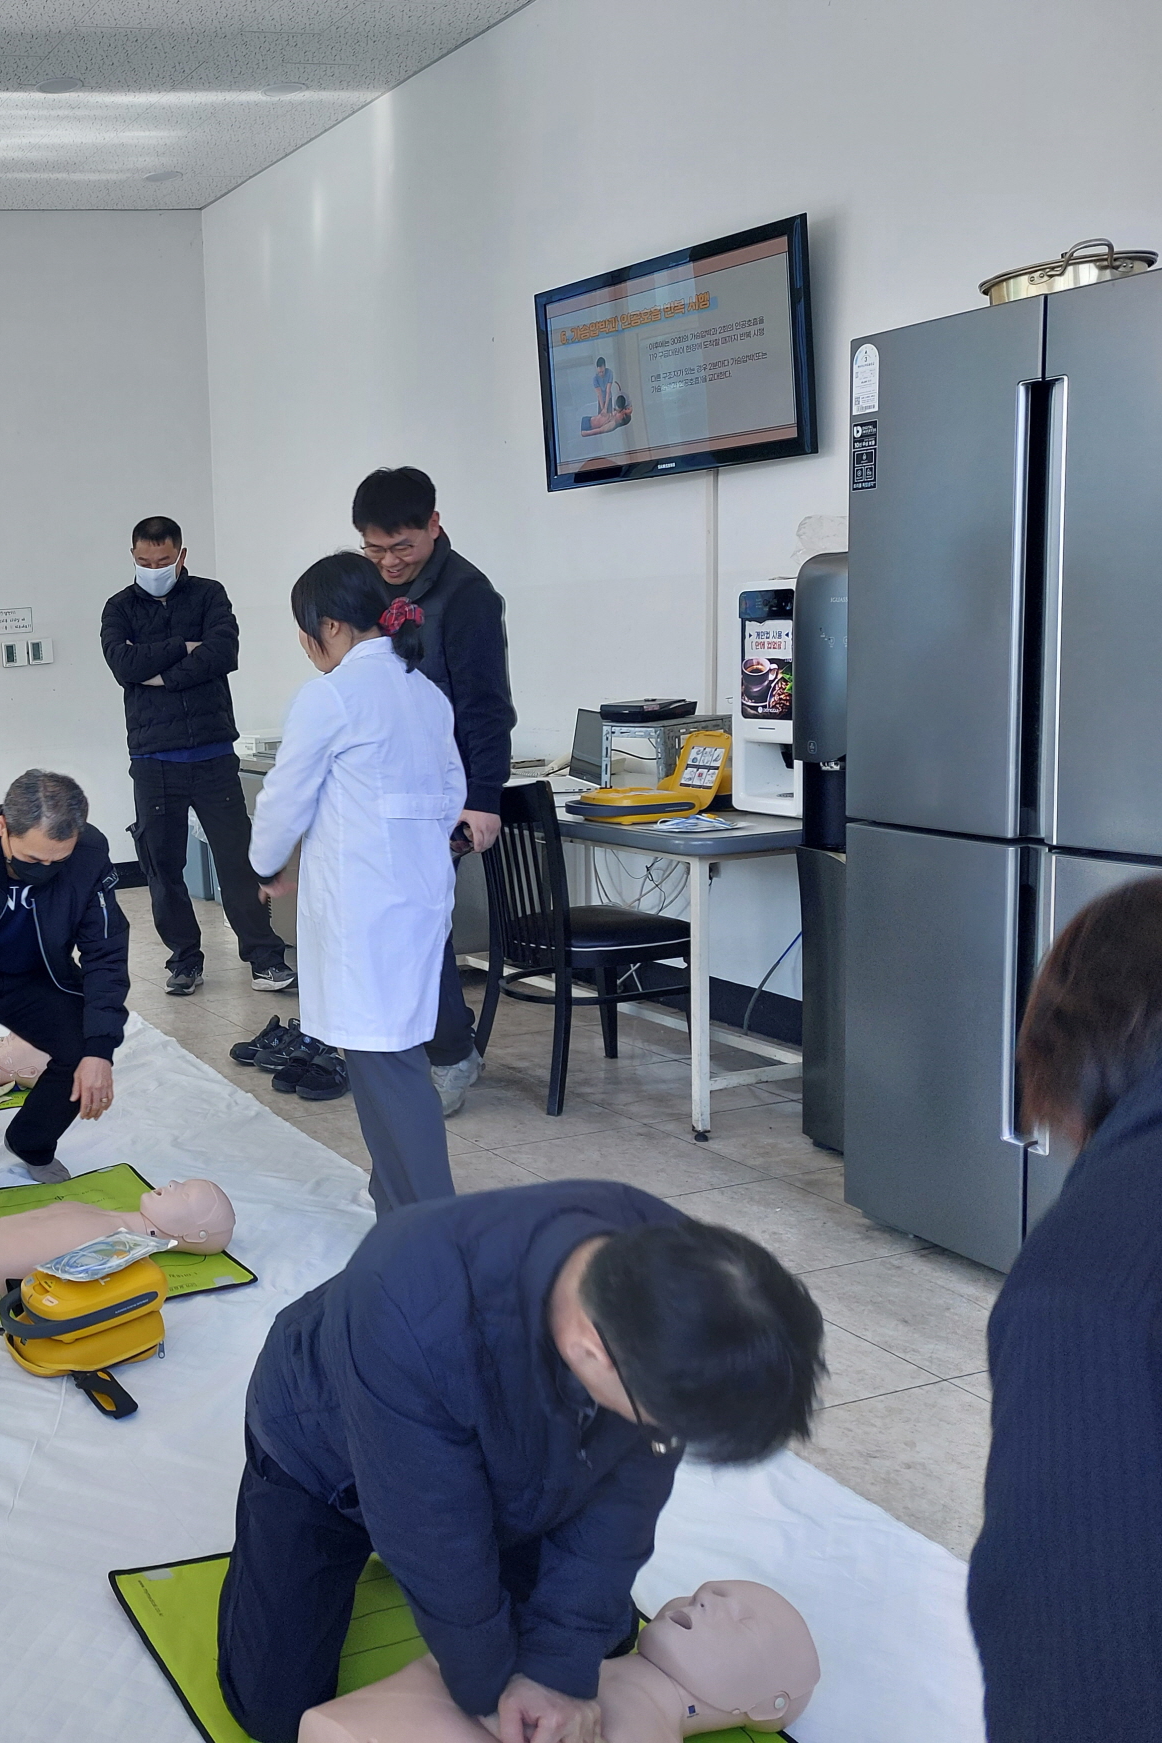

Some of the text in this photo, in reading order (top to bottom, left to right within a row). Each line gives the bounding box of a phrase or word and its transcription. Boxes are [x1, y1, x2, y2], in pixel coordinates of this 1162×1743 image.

[571, 315, 618, 342] 가슴압박과
[620, 305, 662, 330] 인공호흡
[663, 298, 686, 318] 반복
[687, 291, 711, 312] 시행
[649, 352, 658, 361] 119
[771, 630, 783, 640] 사용
